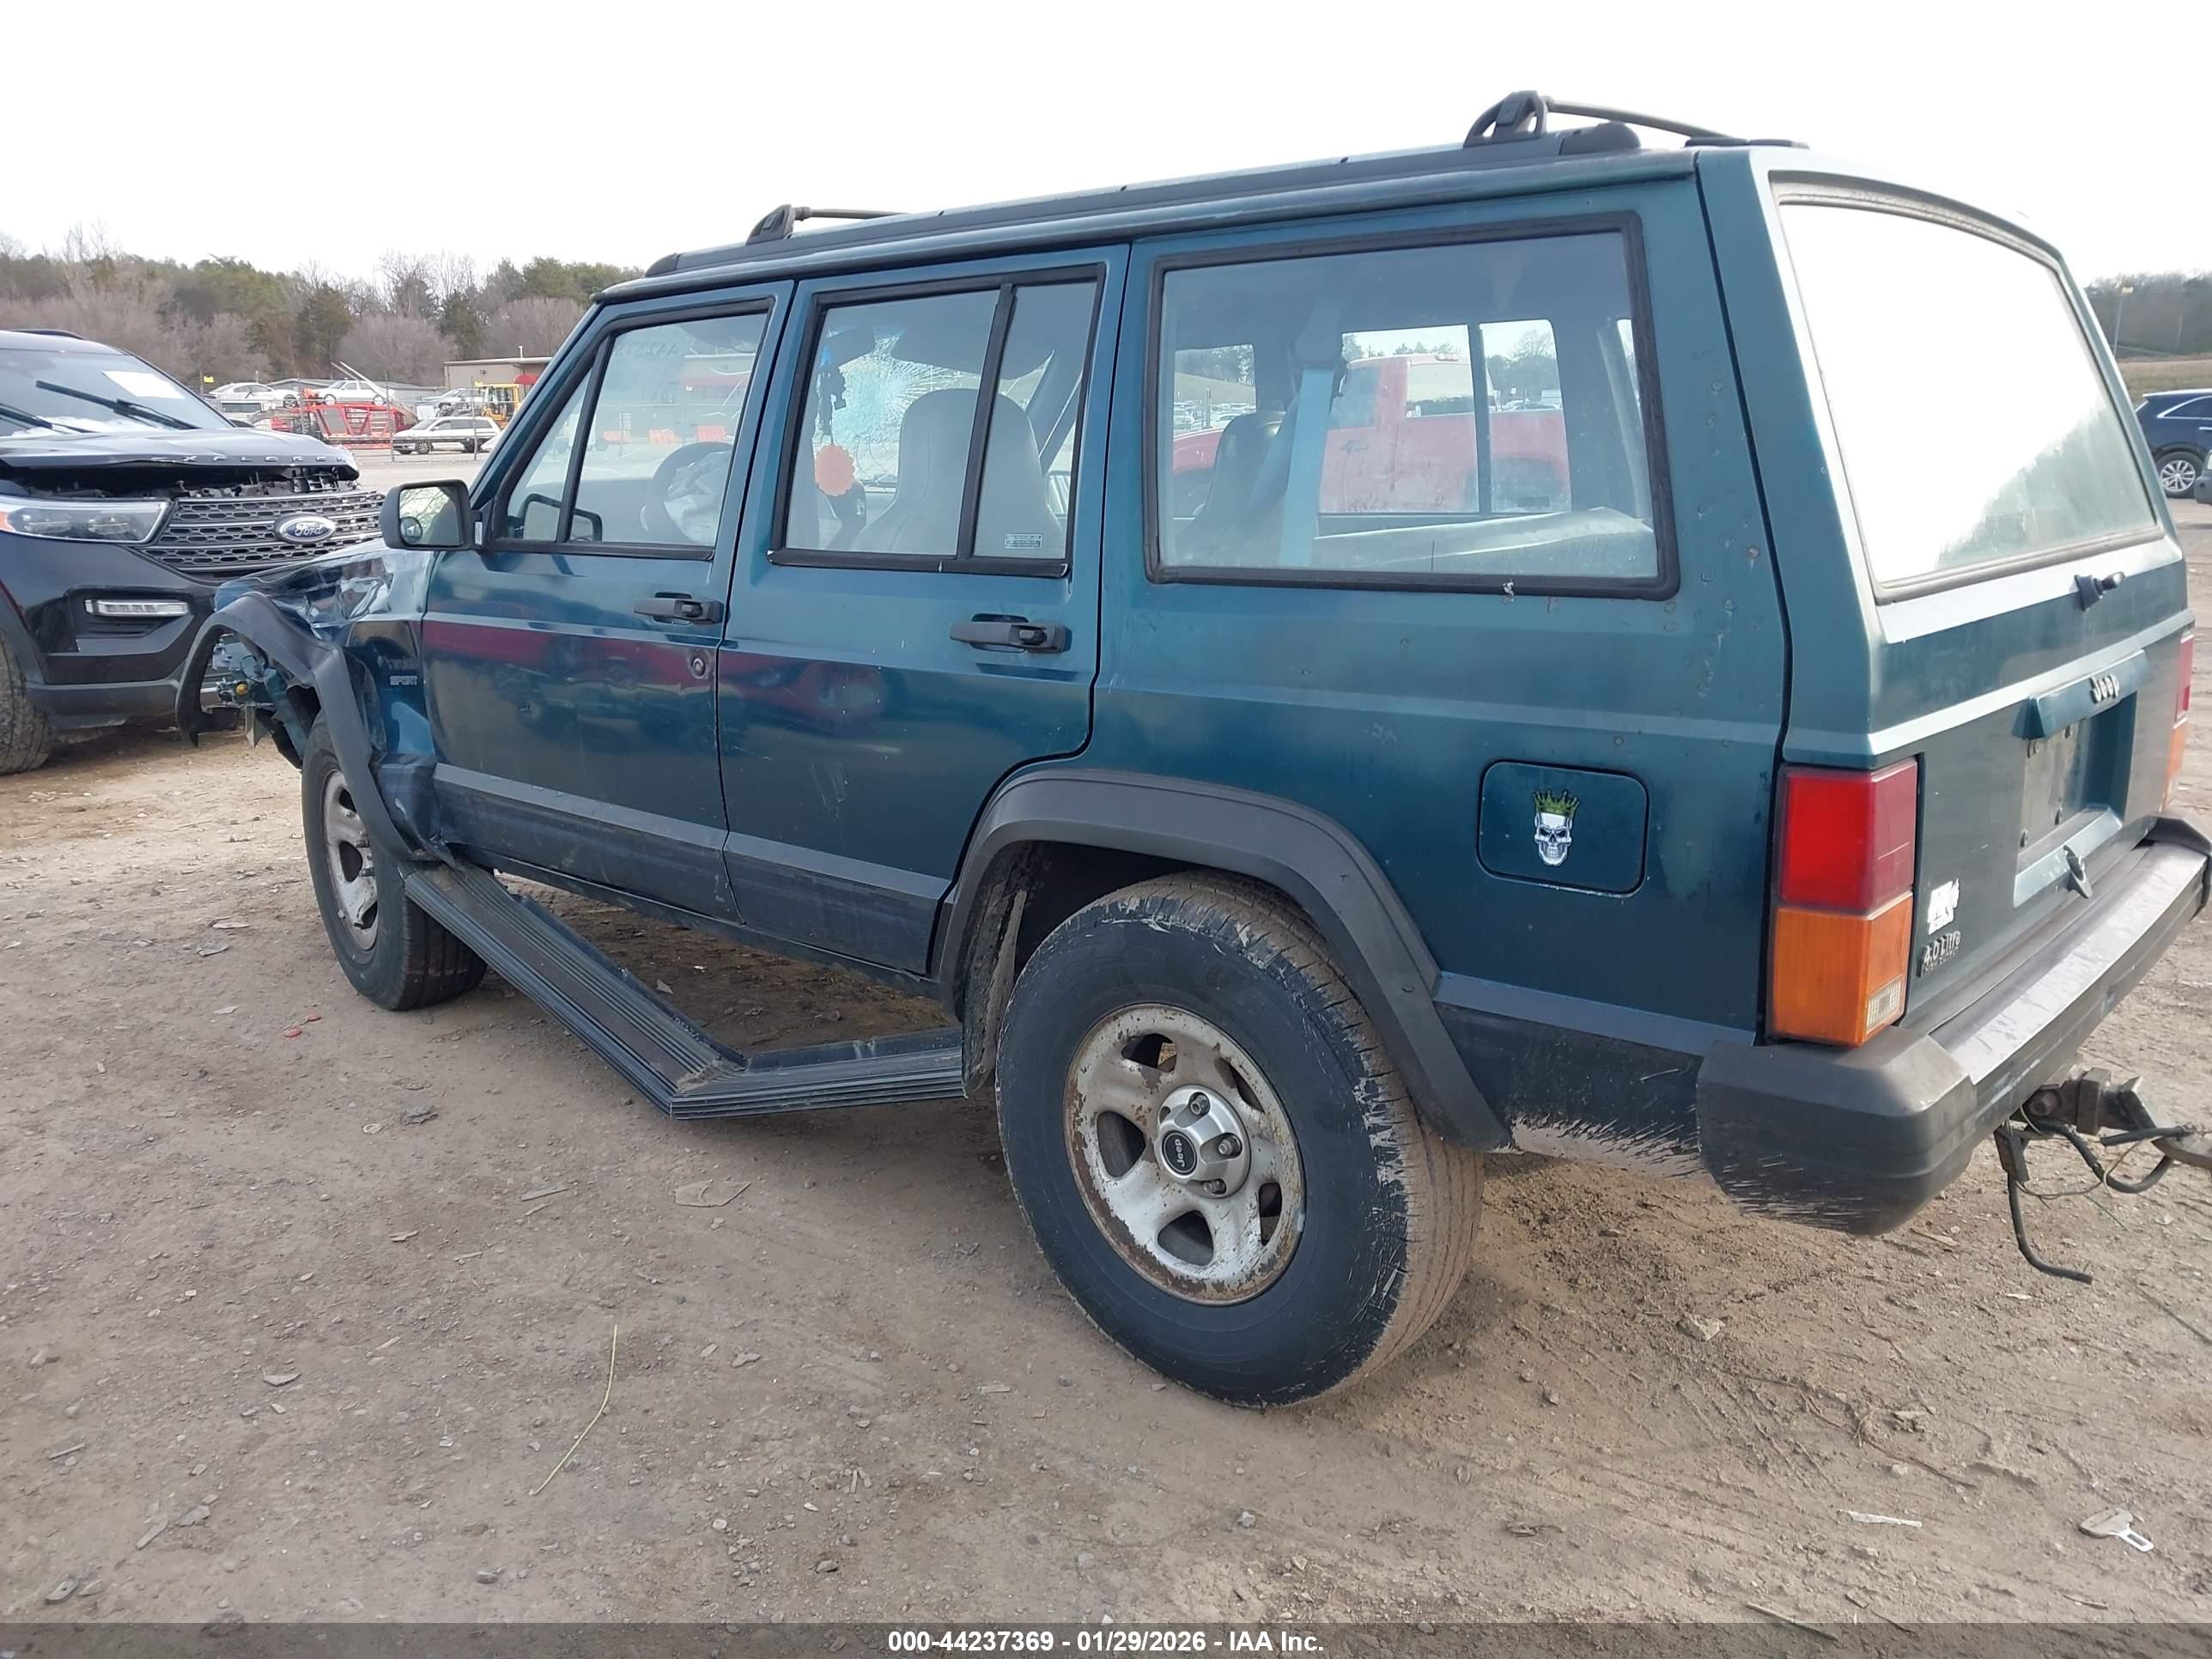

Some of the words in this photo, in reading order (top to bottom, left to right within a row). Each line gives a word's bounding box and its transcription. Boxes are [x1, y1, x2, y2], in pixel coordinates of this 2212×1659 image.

[151, 455, 346, 464] EXPLORER
[294, 521, 324, 538] Ford
[2091, 673, 2119, 702] Jeep
[1175, 1139, 1185, 1168] Jeep
